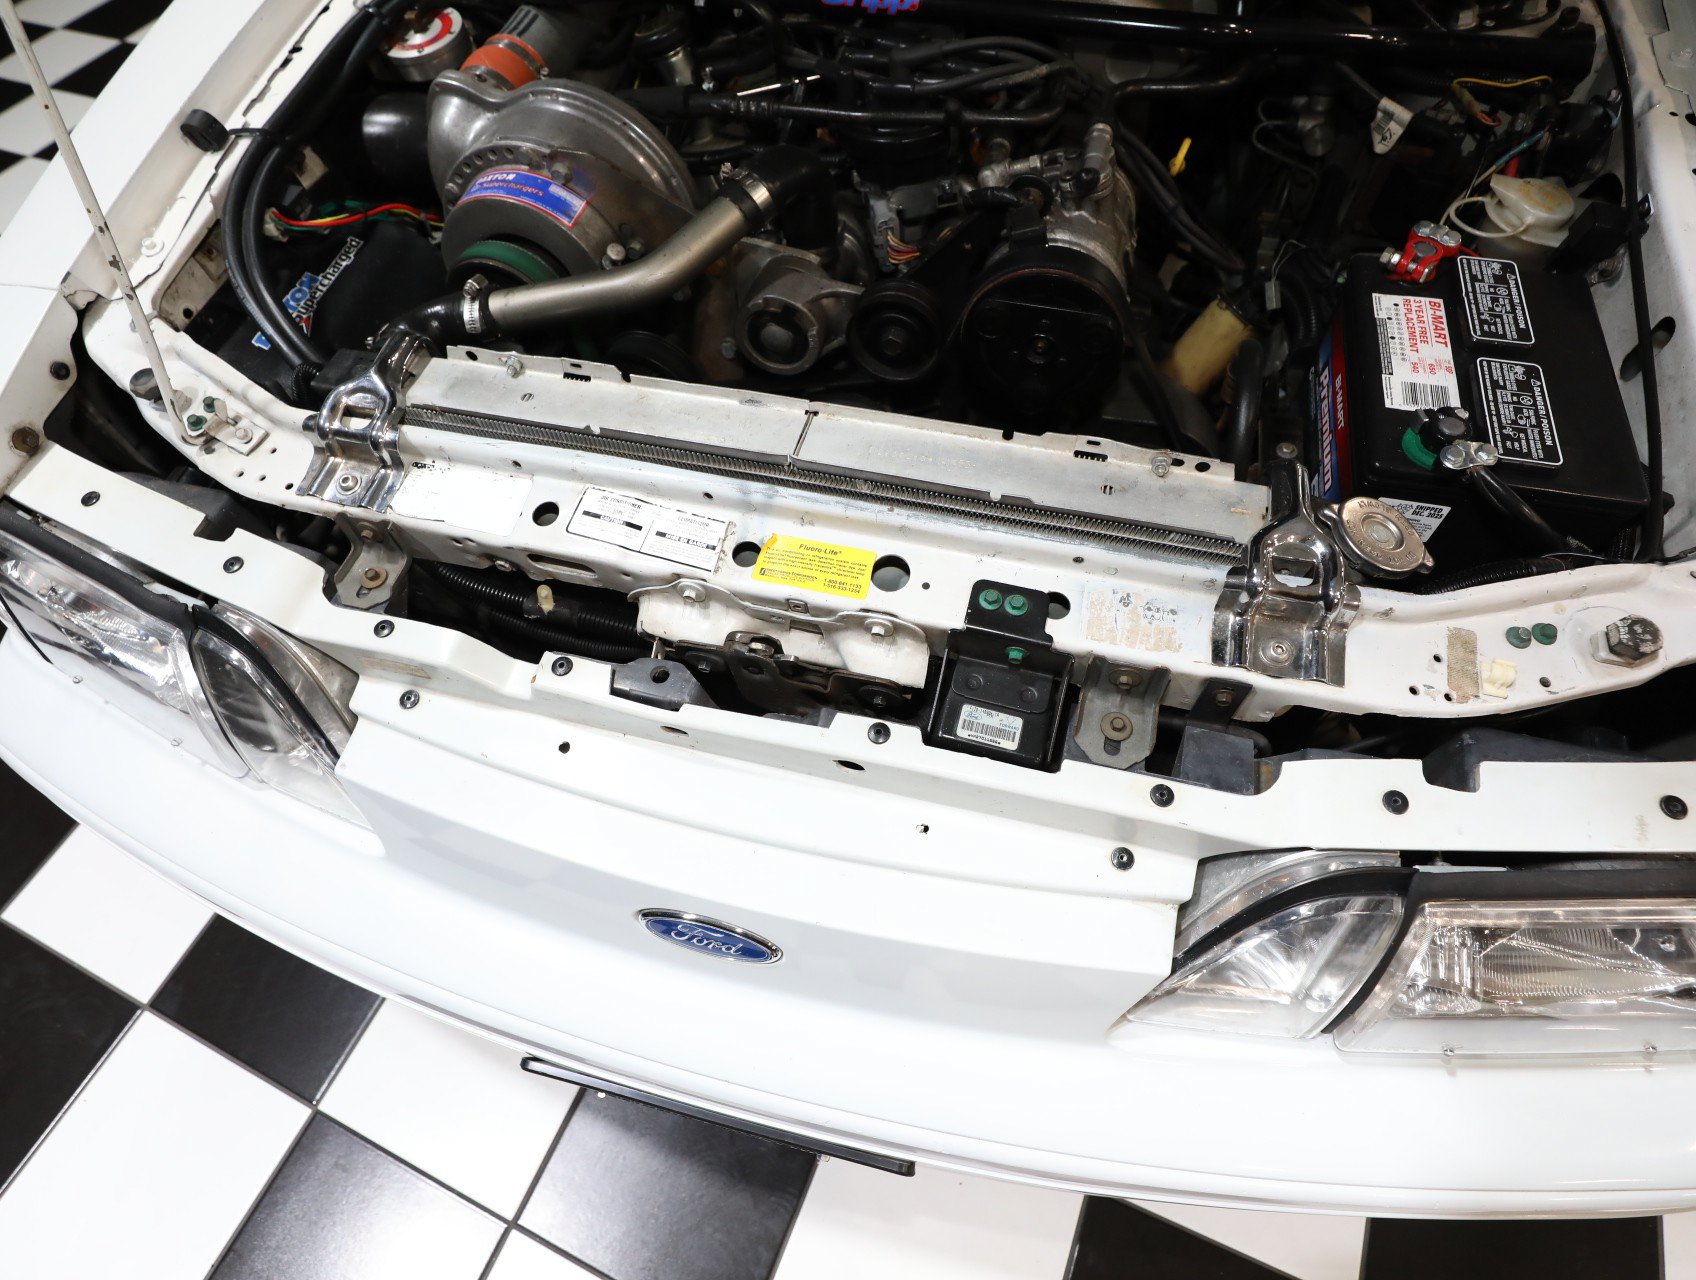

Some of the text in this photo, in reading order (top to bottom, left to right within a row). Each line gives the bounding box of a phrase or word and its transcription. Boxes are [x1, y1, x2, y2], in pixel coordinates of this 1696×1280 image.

[482, 182, 544, 196] Superchargers
[1403, 298, 1419, 353] REPLACEMENT
[1415, 304, 1425, 325] YEAR
[1429, 300, 1448, 347] BI-MART
[1418, 326, 1428, 345] FREE
[1335, 372, 1344, 430] BI-MART
[1320, 366, 1332, 496] Premium
[1415, 505, 1443, 513] SHIPPED
[671, 924, 743, 954] Ford
